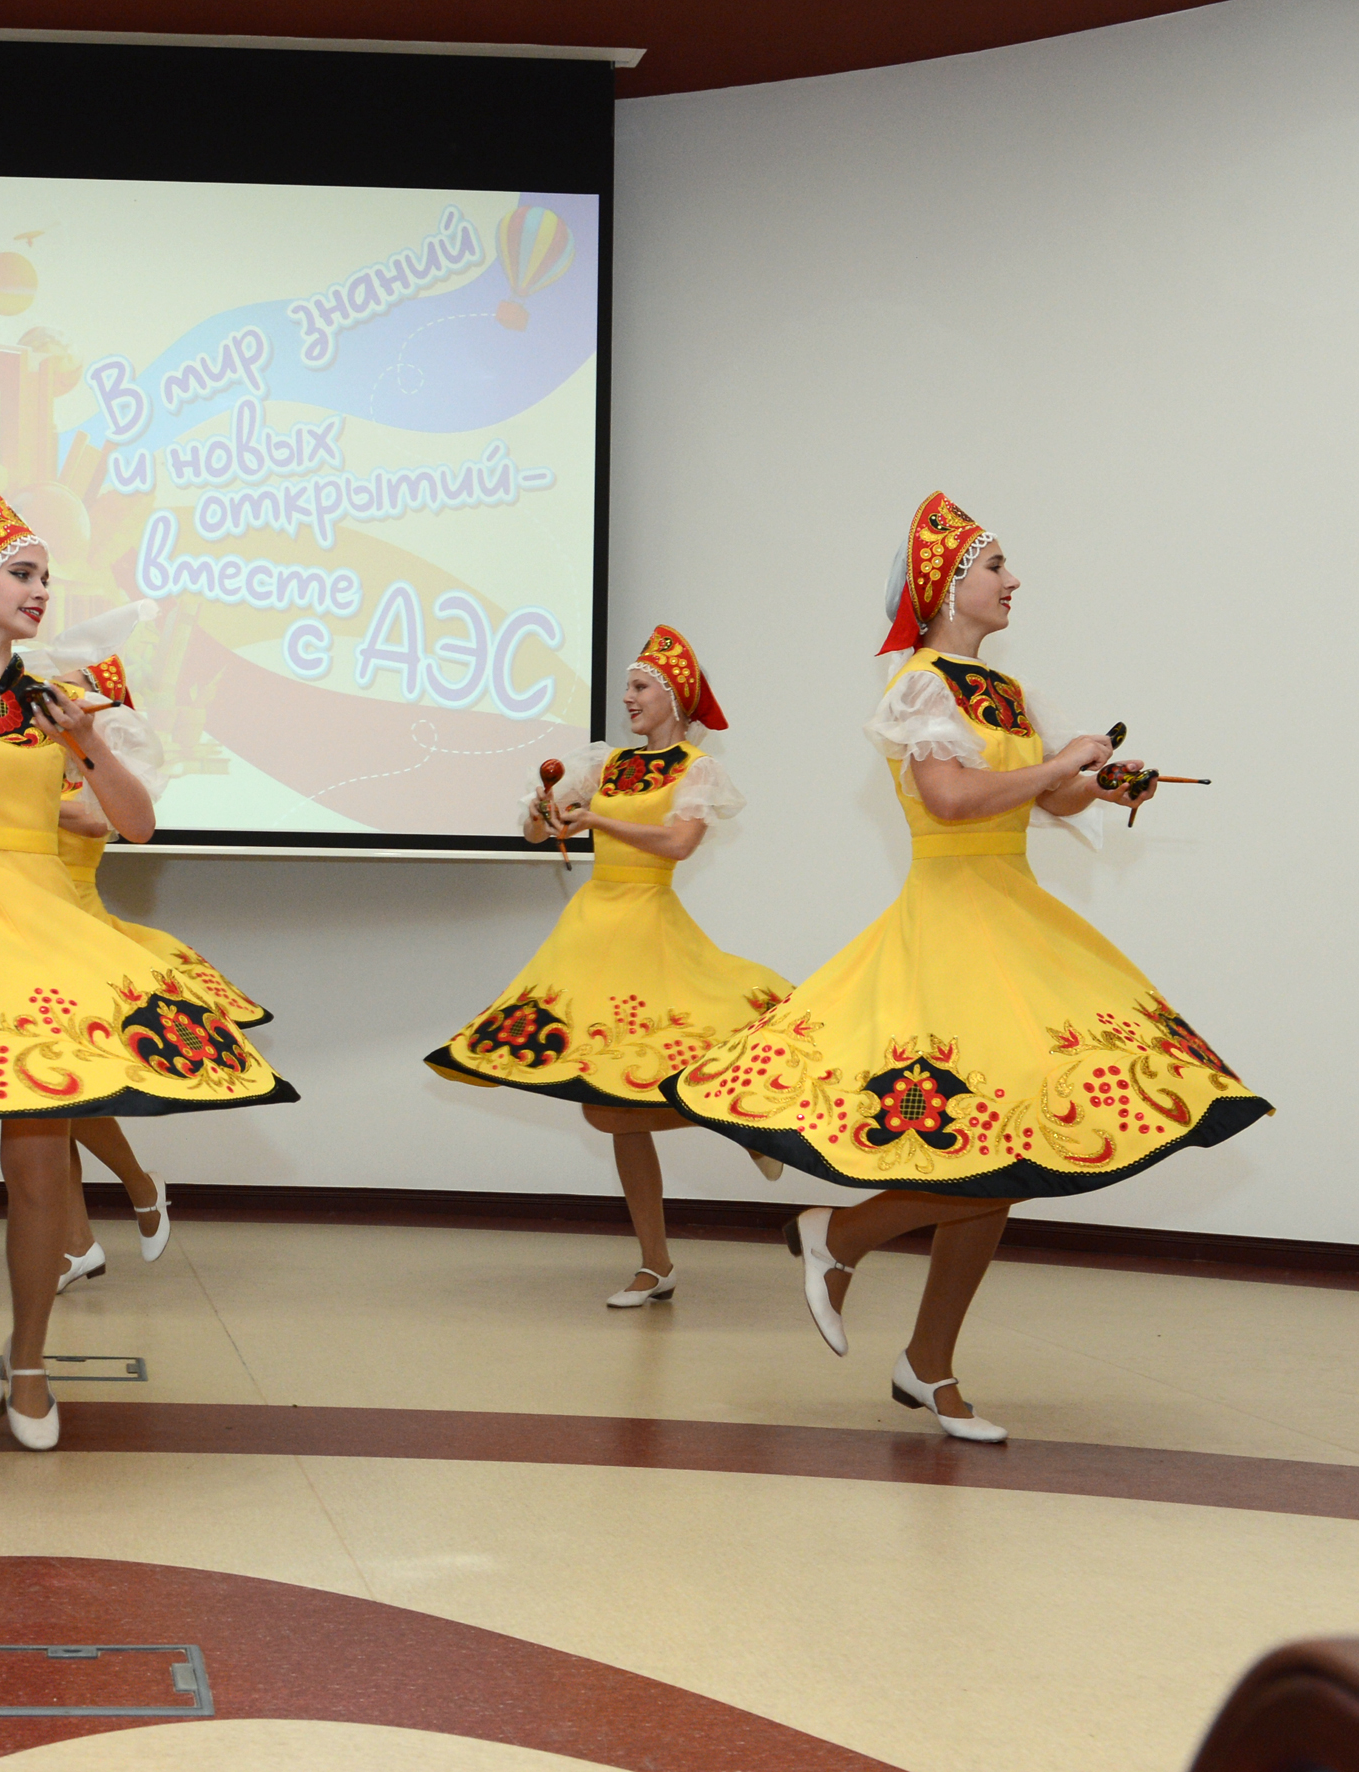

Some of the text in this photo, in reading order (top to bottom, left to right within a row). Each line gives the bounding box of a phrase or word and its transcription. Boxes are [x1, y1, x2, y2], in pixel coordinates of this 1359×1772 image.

[90, 210, 478, 436] В мир знаний
[112, 400, 339, 488] и новых
[142, 515, 357, 610] вместе
[287, 586, 558, 714] с АЭС
